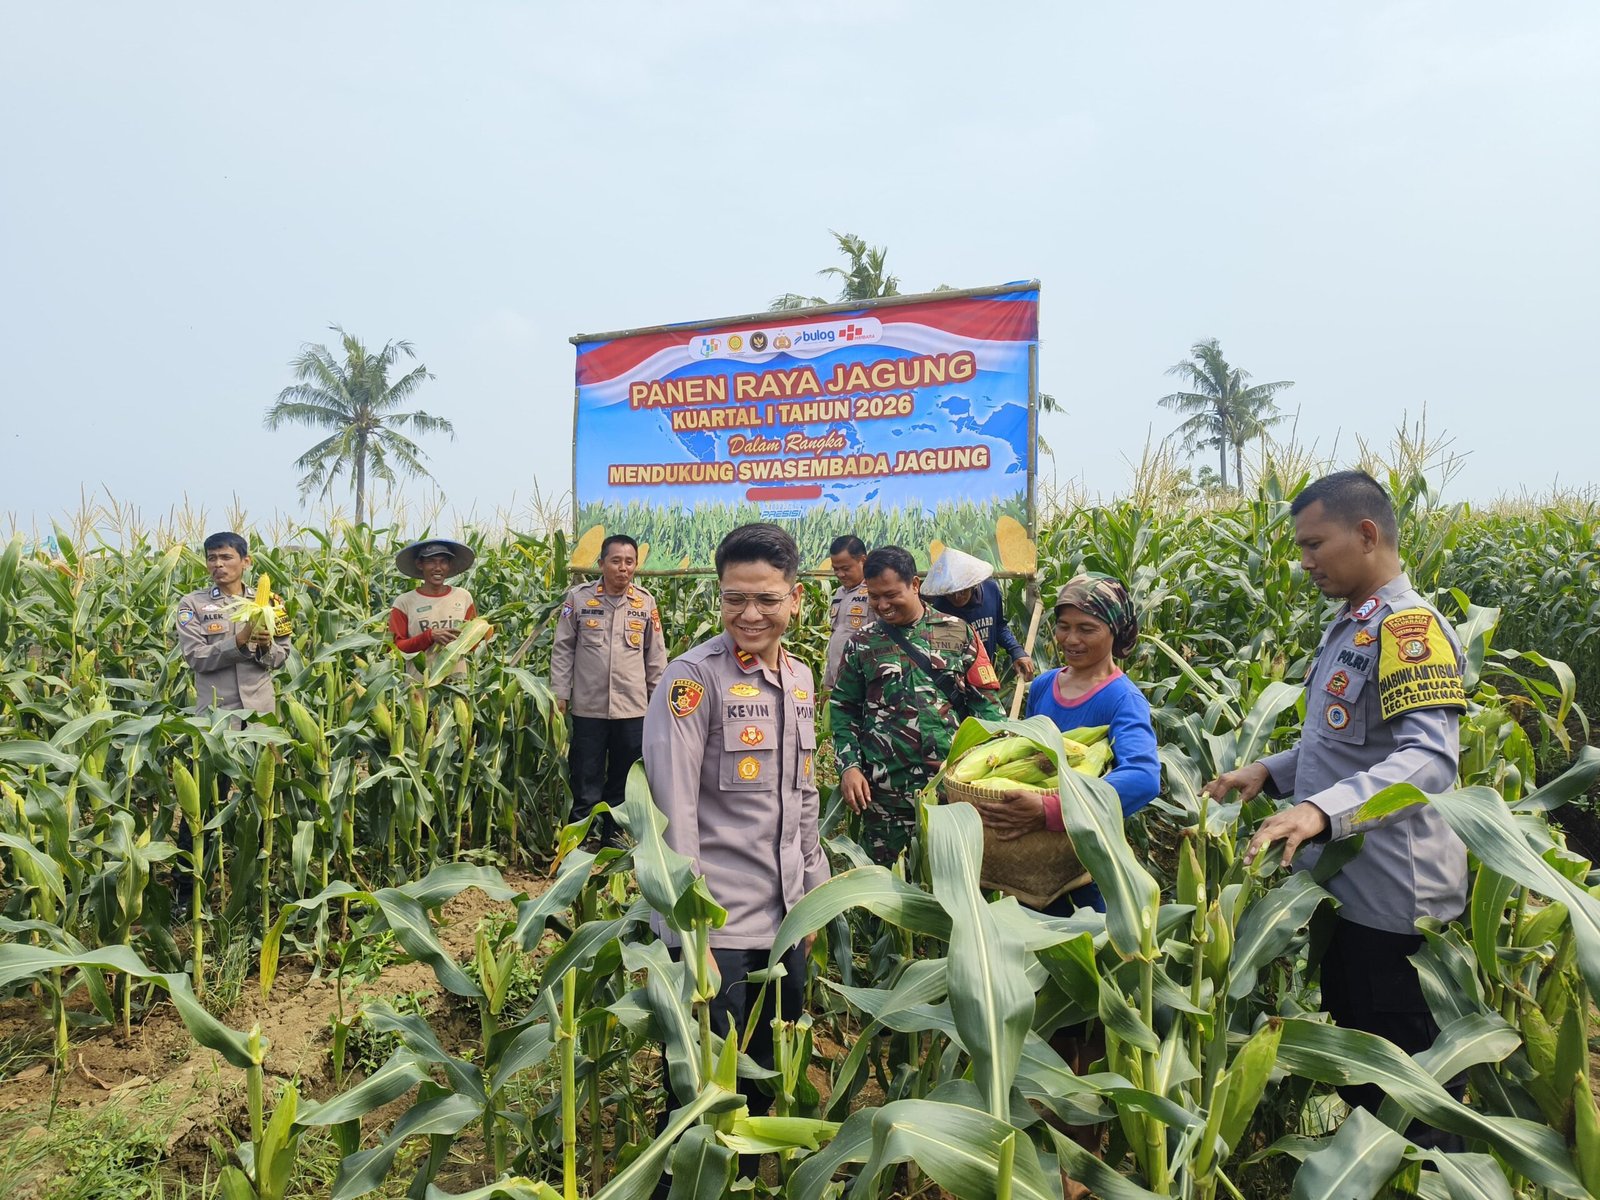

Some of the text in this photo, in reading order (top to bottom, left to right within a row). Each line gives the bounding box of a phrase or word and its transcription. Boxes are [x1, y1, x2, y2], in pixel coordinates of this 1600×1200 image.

[803, 329, 835, 343] bulog
[631, 354, 973, 407] PANEN RAYA JAGUNG
[673, 395, 912, 430] KUARTAL I TAHUN 2026
[729, 431, 845, 456] Dalam Rangka
[609, 447, 988, 484] MENDUKUNG SWASEMBADA JAGUNG
[762, 509, 802, 518] PRESISI
[203, 613, 224, 621] ALEK
[627, 610, 647, 618] POLRI
[970, 616, 994, 630] RVARD
[936, 641, 951, 649] TNI
[1337, 649, 1370, 672] POLRI
[1380, 663, 1461, 697] BHABINKAMTIBMA
[728, 704, 769, 718] KEVIN
[1385, 690, 1465, 716] KEC.TELUKNAG
